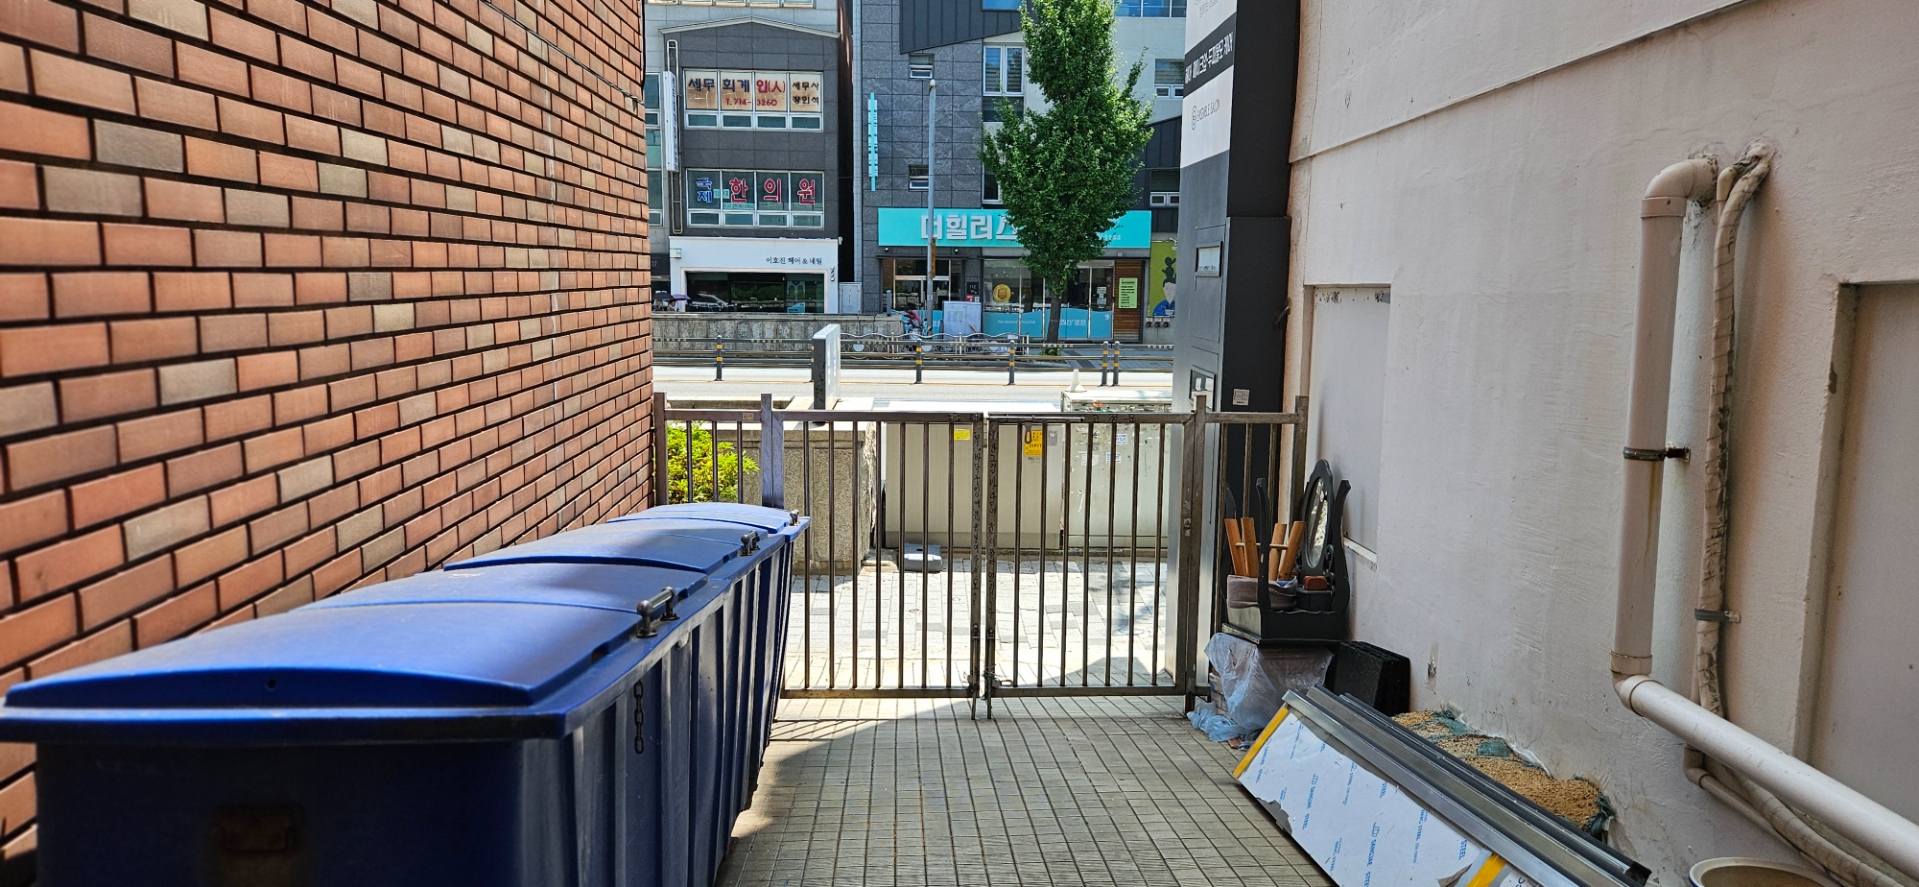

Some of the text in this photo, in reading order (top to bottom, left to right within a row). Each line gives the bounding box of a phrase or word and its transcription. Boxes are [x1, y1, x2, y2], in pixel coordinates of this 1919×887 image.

[688, 78, 715, 92] 세무
[722, 78, 750, 93] 회계
[792, 81, 820, 91] 세무사
[729, 177, 816, 205] 한의원
[765, 256, 786, 265] 이호진
[788, 256, 801, 265] 헤어
